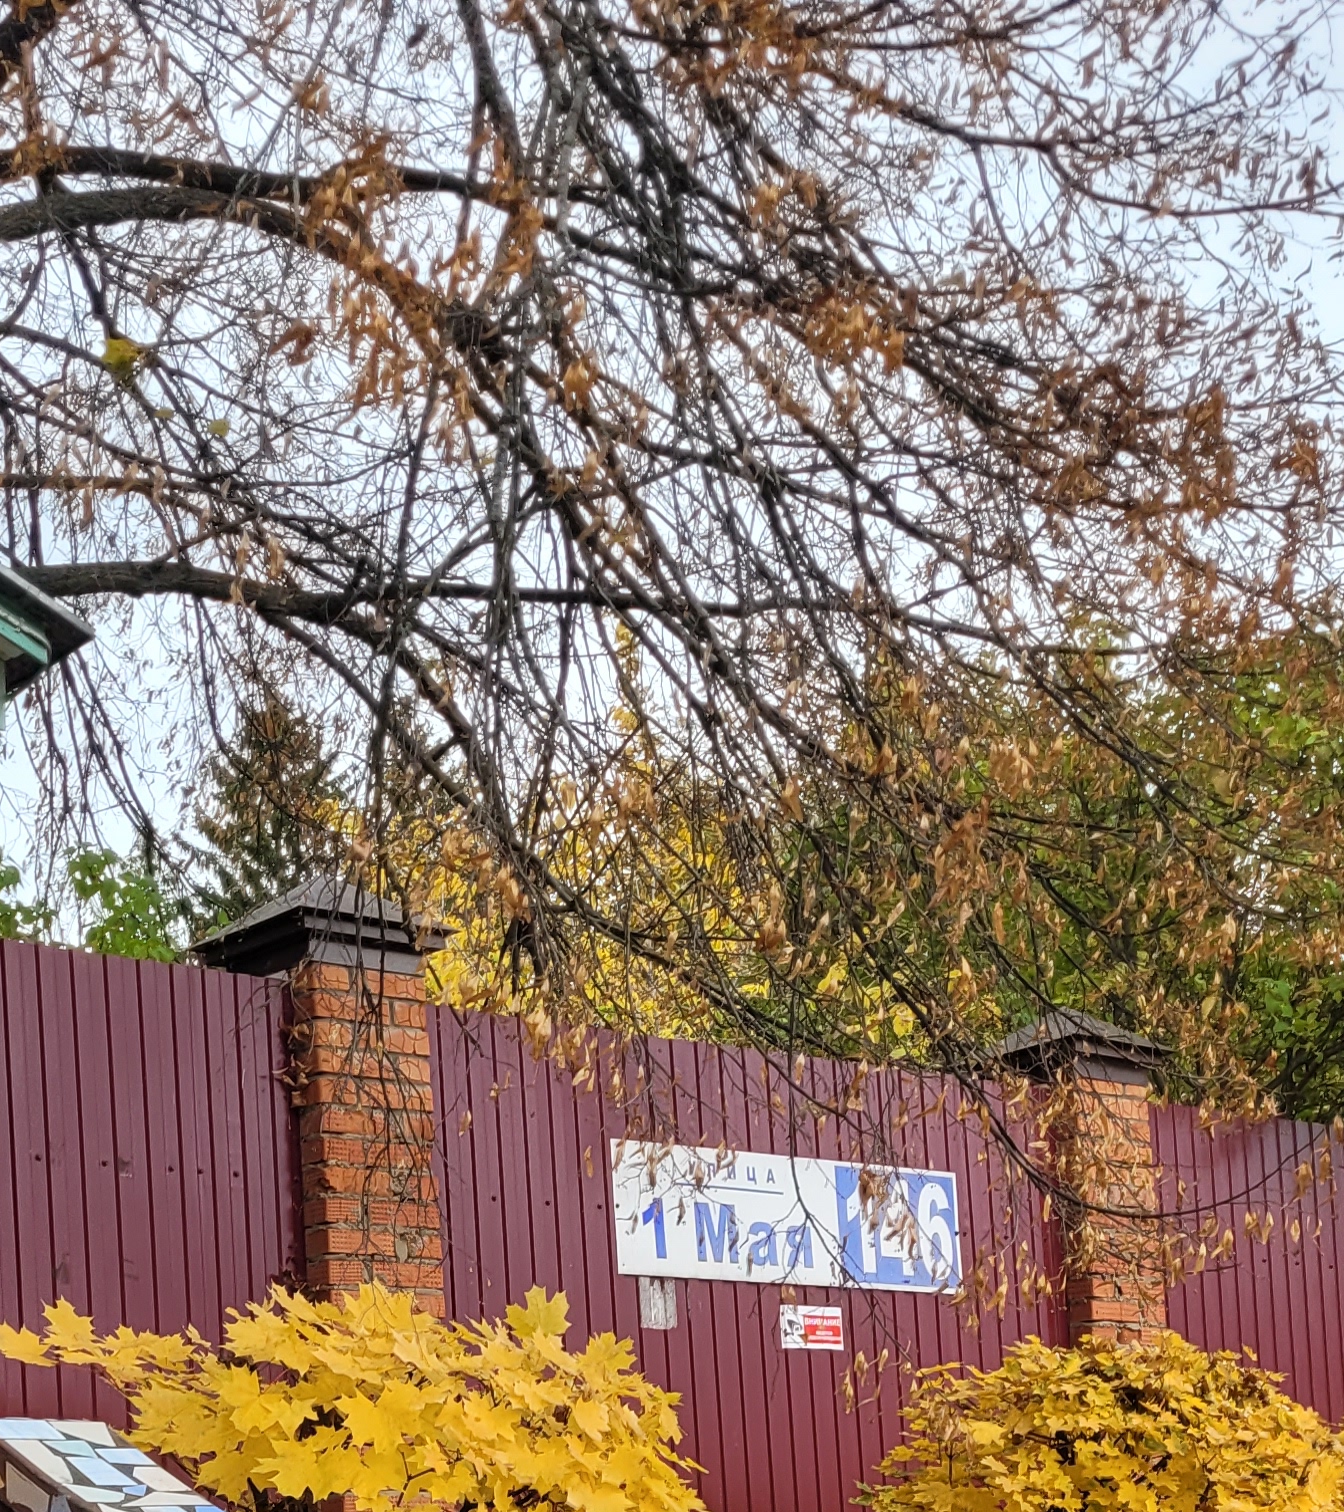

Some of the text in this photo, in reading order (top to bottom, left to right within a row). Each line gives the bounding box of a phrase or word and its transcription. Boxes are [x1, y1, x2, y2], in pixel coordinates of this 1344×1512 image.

[642, 1198, 815, 1269] 1 Мая
[846, 1175, 953, 1280] 146
